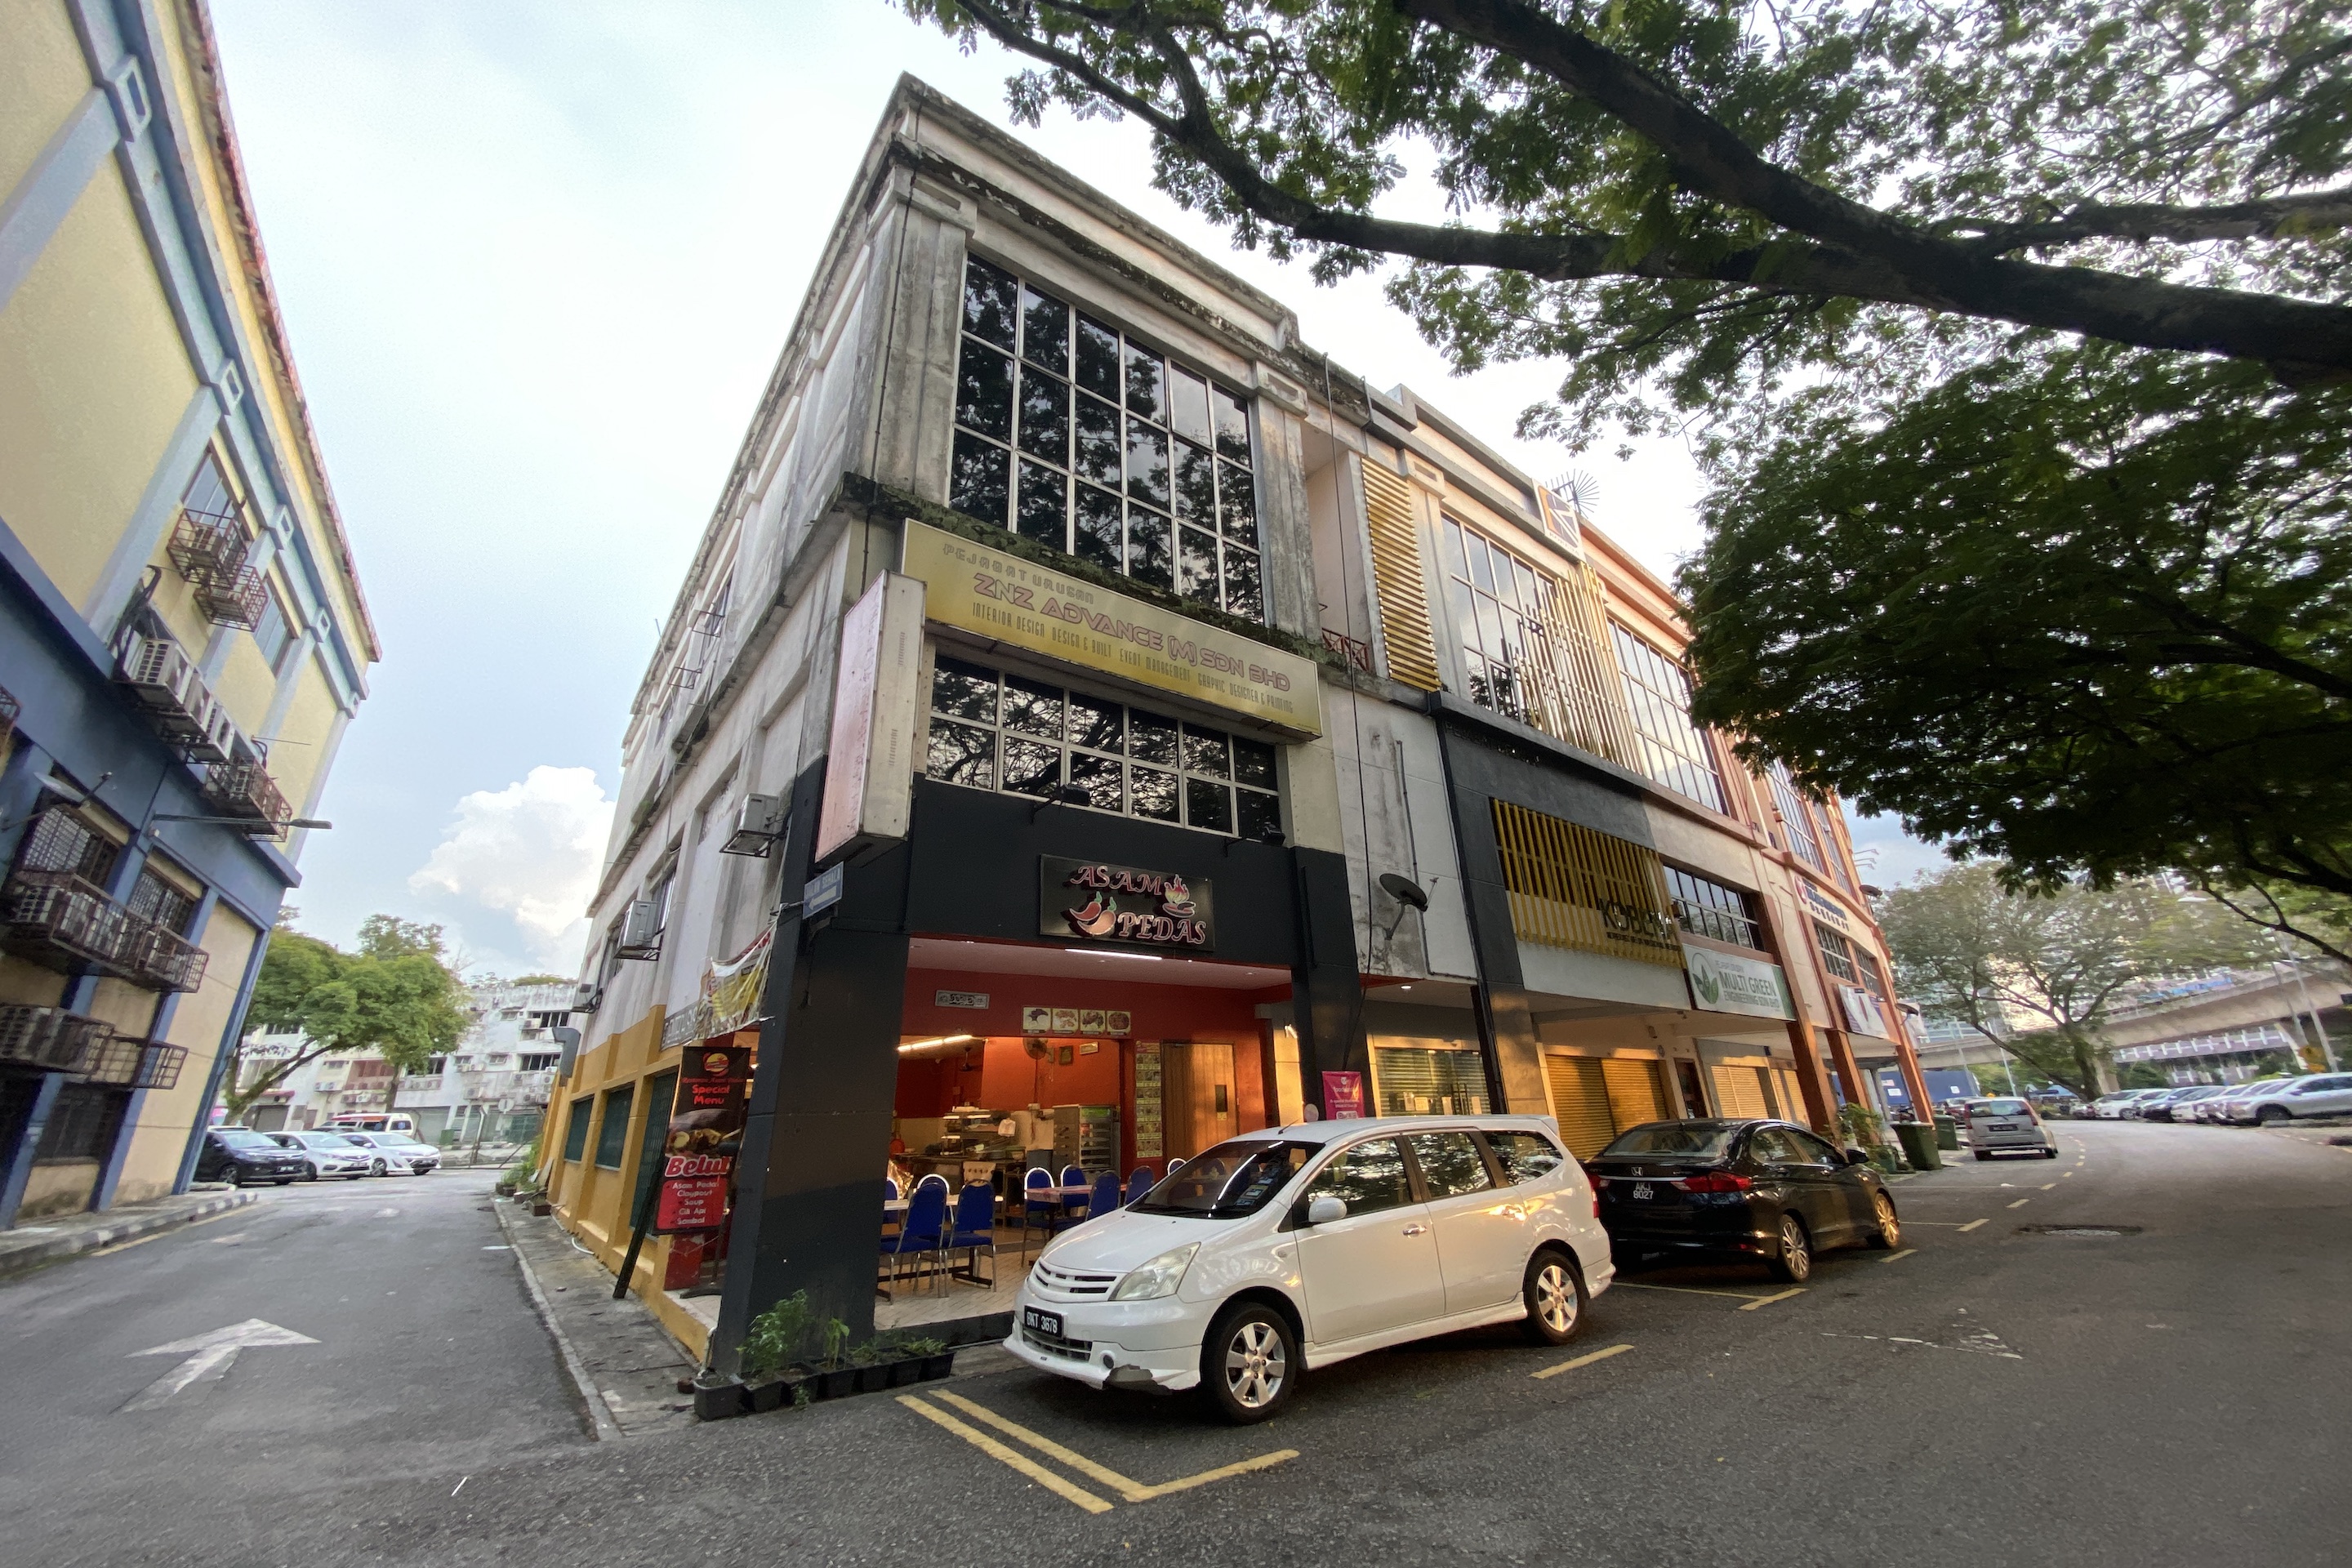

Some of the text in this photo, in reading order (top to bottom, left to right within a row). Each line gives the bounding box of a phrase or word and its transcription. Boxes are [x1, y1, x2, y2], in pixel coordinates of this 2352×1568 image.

[942, 544, 1094, 604] PEJABAT URUSAN
[973, 572, 1290, 692] ZNZ ADVANCE (M) SDN BHD
[973, 602, 1013, 627] INTERIOR
[1016, 616, 1045, 637] DESIGN
[1052, 626, 1080, 648] DESIGN
[1092, 639, 1111, 658] BUILT
[1120, 648, 1141, 667] EVENT
[1146, 656, 1191, 683] MANAGEMENT
[1197, 672, 1226, 693] GRAPHIC
[1229, 683, 1259, 703] DESIGNER
[1267, 694, 1294, 714] PRINTING
[1070, 865, 1162, 896] ASAM
[1116, 911, 1207, 945] PEDAS
[1718, 970, 1777, 996] MULTI GREEN
[692, 1084, 731, 1095] Special
[693, 1095, 724, 1105] Menu
